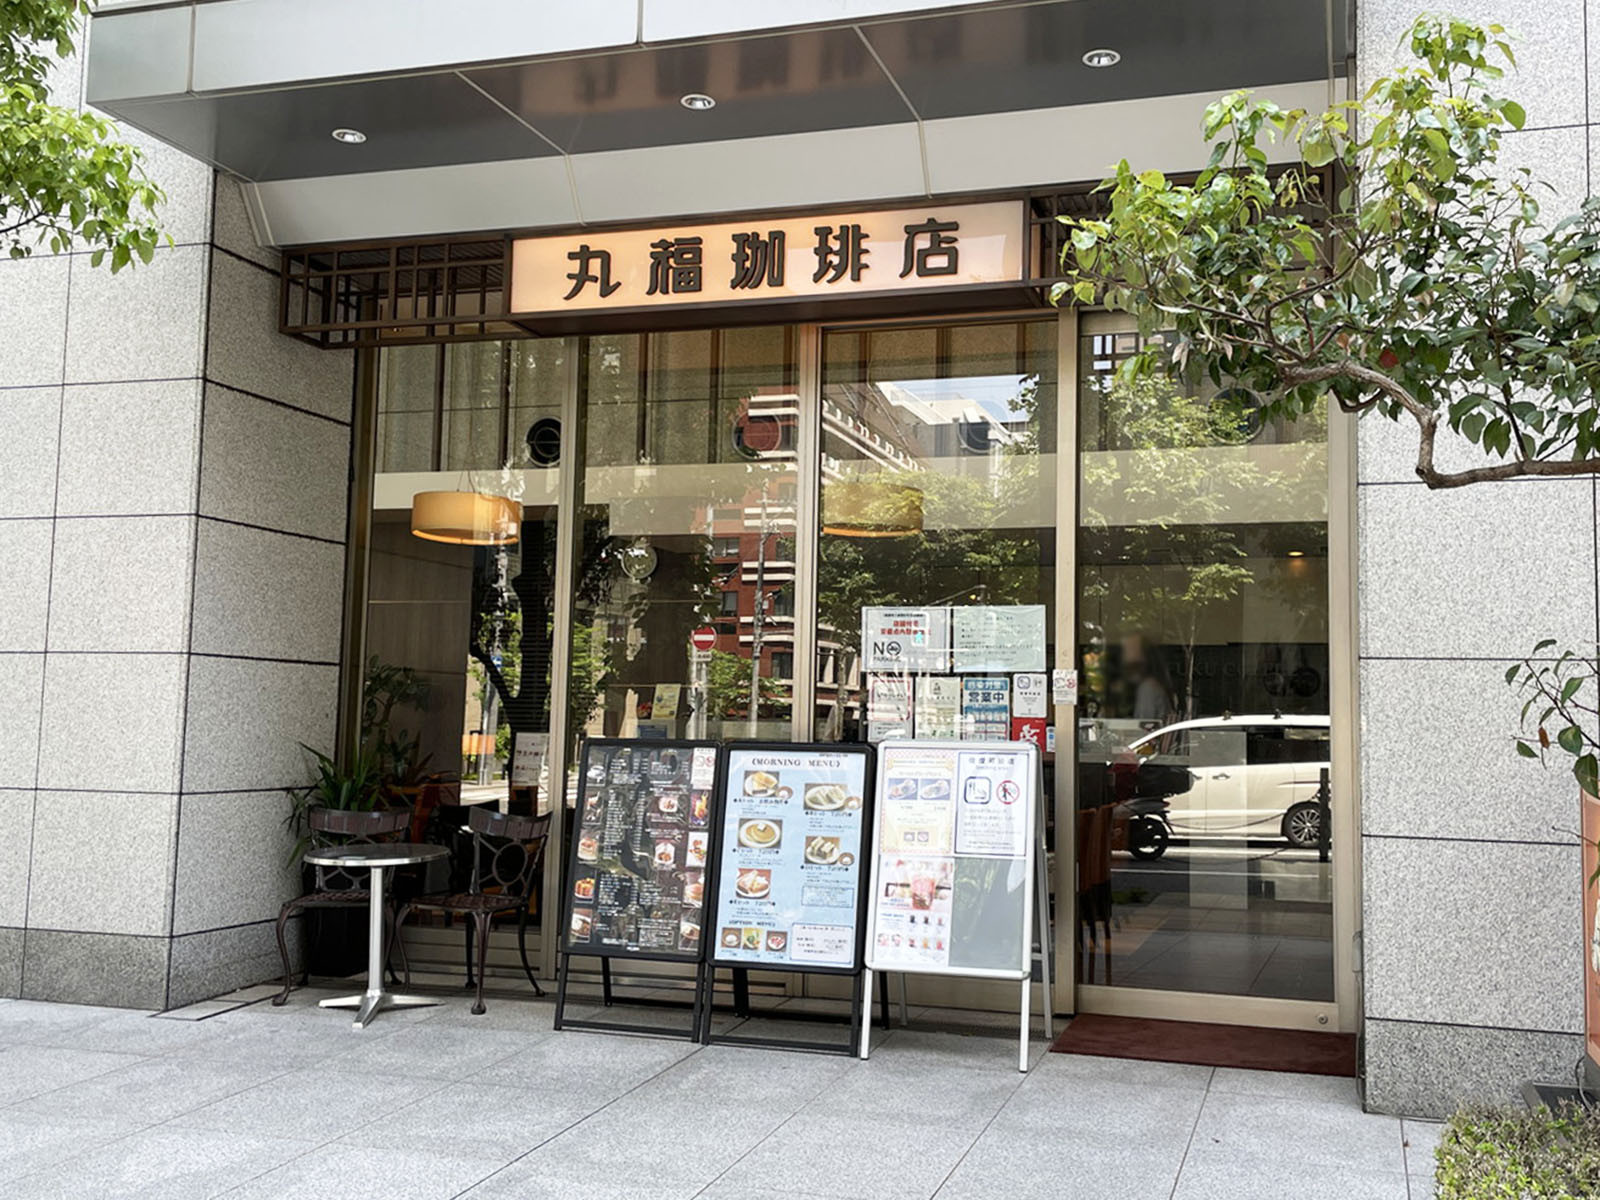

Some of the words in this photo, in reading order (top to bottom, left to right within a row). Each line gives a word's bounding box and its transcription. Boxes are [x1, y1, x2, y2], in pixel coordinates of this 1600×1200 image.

[563, 217, 961, 300] 丸福珈琲店
[968, 691, 1005, 703] 営業中
